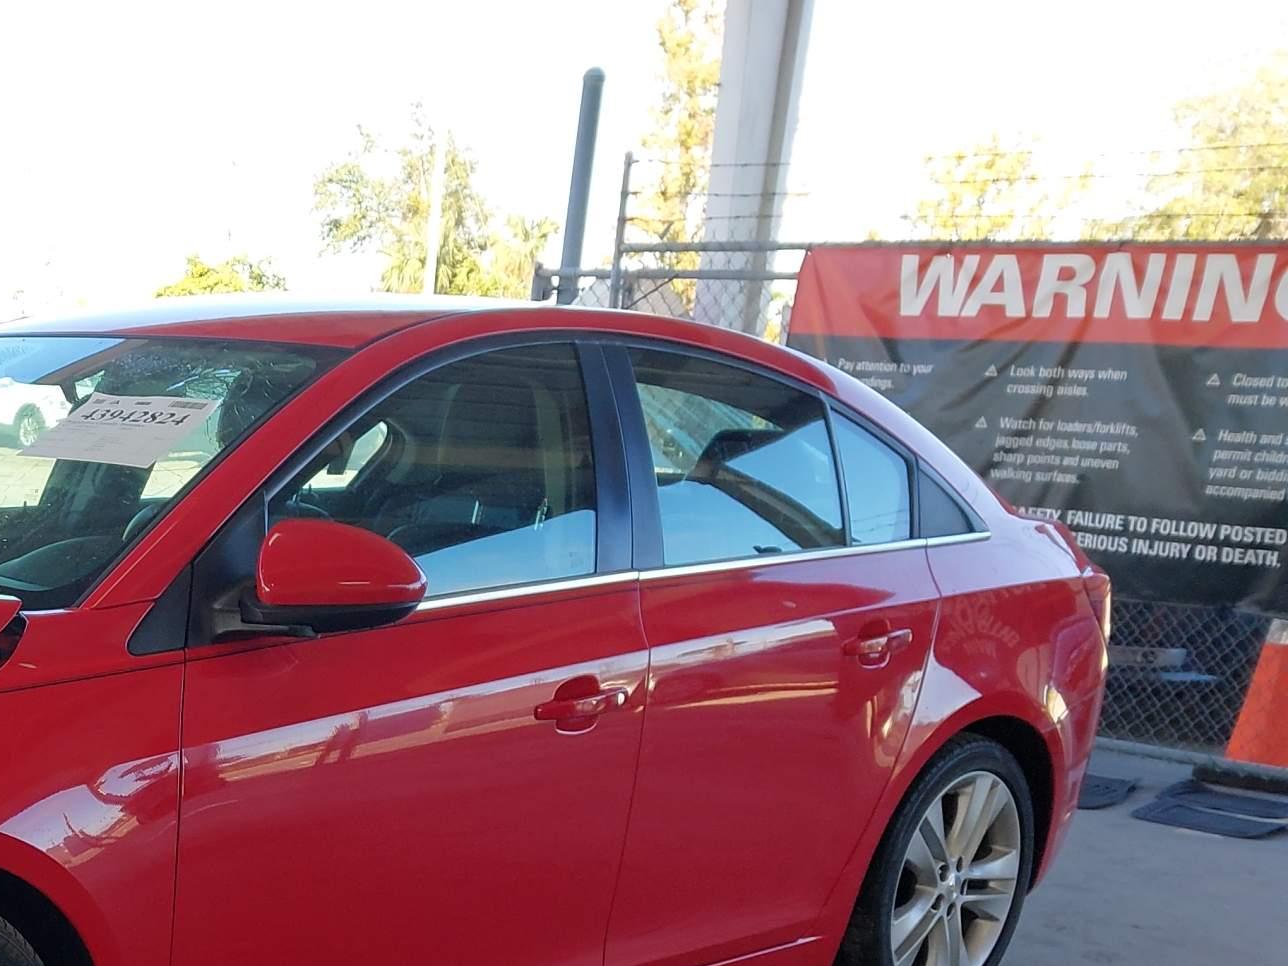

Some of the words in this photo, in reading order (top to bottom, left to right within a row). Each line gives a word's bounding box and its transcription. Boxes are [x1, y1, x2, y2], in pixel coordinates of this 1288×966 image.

[900, 252, 1288, 323] WARNIN
[838, 358, 853, 372] Pay
[856, 360, 897, 372] attention
[900, 363, 911, 373] to
[912, 364, 935, 376] your
[1010, 365, 1035, 377] Look
[1039, 366, 1064, 378] both
[1068, 369, 1095, 382] ways
[1098, 368, 1127, 380] when
[1232, 373, 1275, 388] Closed
[1007, 383, 1054, 397] crossing
[1227, 394, 1258, 406] must
[1261, 393, 1277, 406] be
[81, 409, 190, 426] 43942824
[1000, 417, 1035, 430] Watch
[1039, 418, 1054, 431] for
[995, 434, 1033, 449] jagged
[1072, 438, 1098, 449] loose
[1099, 441, 1130, 454] parts,
[1218, 430, 1257, 444] Health
[1259, 433, 1284, 445] and
[993, 452, 1024, 465] sharp
[1026, 453, 1060, 466] points
[1081, 457, 1119, 469] uneven
[1213, 448, 1252, 462] permit
[1254, 450, 1288, 464] childr
[990, 468, 1032, 483] walking
[1208, 466, 1238, 480] yard
[1239, 469, 1254, 479] or
[1205, 485, 1287, 502] accompanied
[1066, 509, 1124, 531] FAILURE
[1128, 515, 1147, 532] TO
[1151, 517, 1216, 538] FOLLOW
[1220, 524, 1287, 545] POSTED
[1072, 531, 1128, 553] ERIOUS
[1132, 538, 1192, 559] INJURY
[1195, 544, 1217, 562] OR
[1220, 547, 1281, 567] DEATH.
